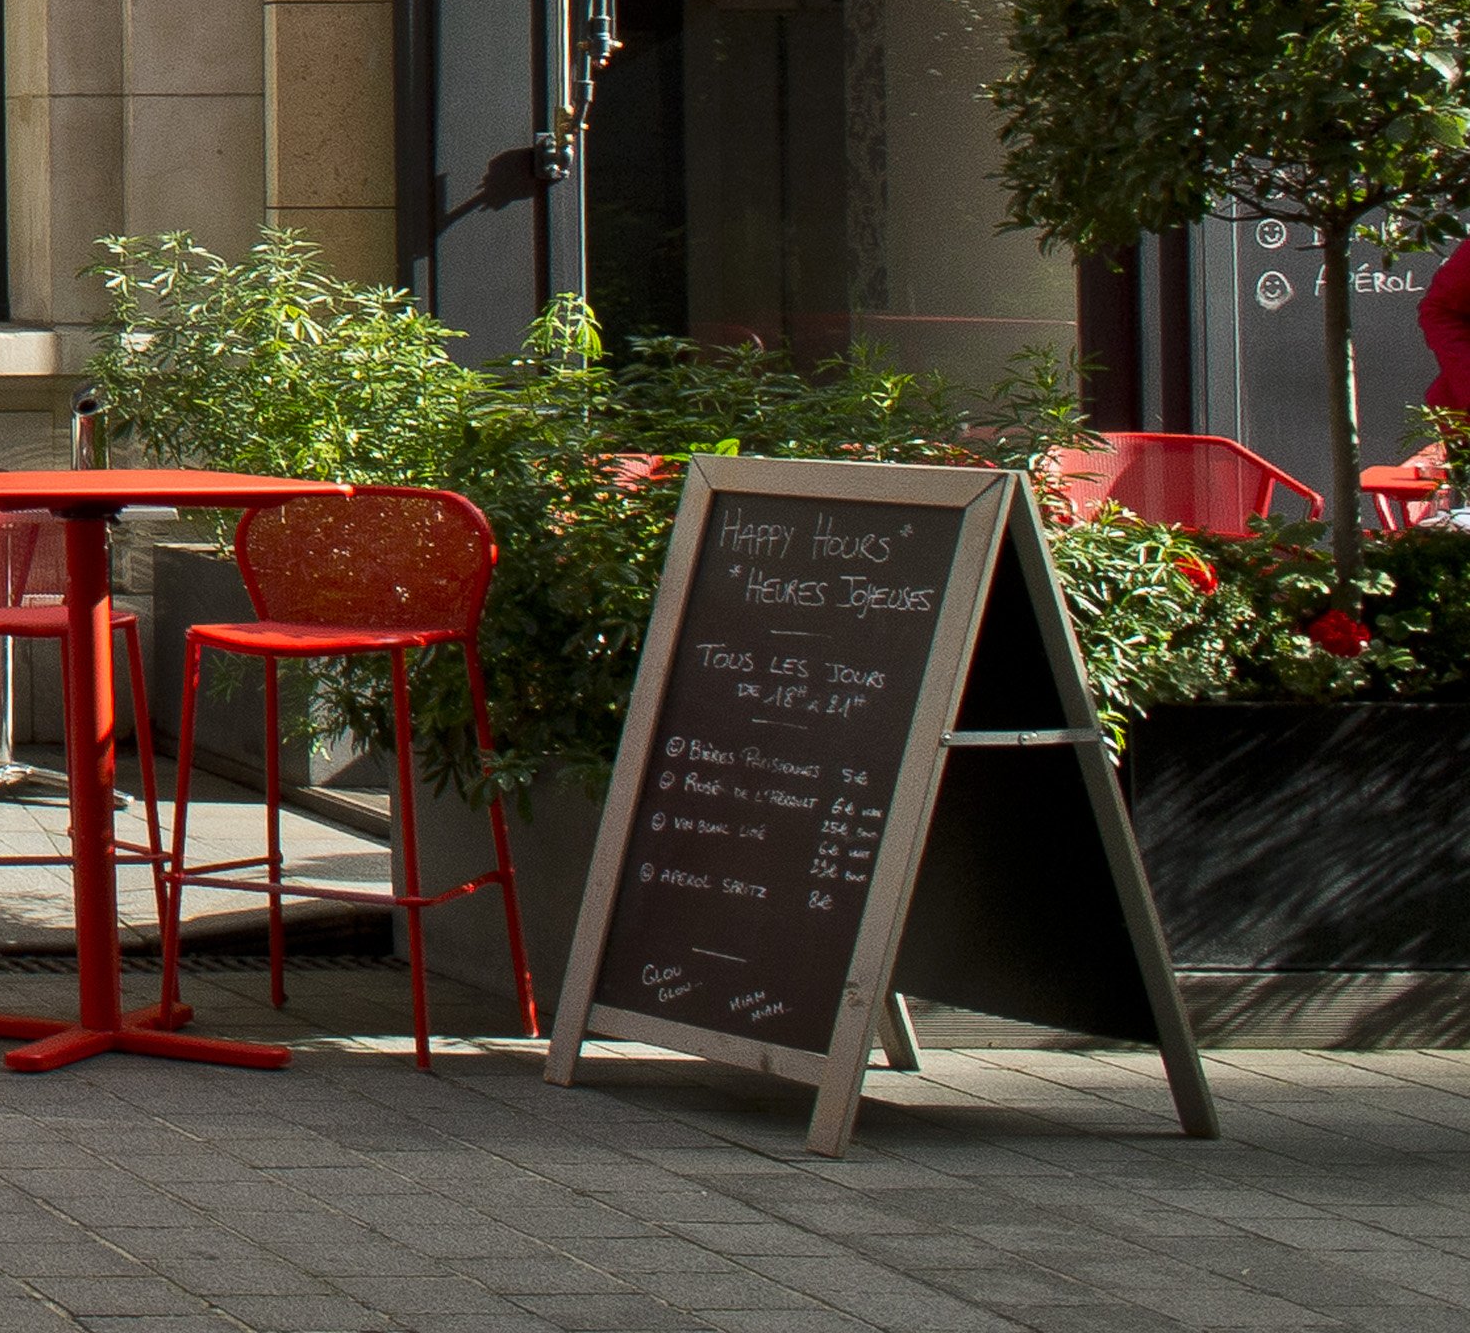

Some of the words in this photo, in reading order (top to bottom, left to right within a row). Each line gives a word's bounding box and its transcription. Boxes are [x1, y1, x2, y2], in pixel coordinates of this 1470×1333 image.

[1313, 262, 1425, 297] AÉROL
[719, 508, 795, 559] HAPPY
[745, 566, 829, 607] HEURES
[836, 575, 934, 619] JOYEUSES
[696, 643, 755, 673] TOUS
[768, 655, 810, 678] LES
[824, 662, 887, 689] JOURS
[737, 682, 762, 698] DE
[841, 768, 869, 786] 5€
[642, 963, 683, 986] GLOU
